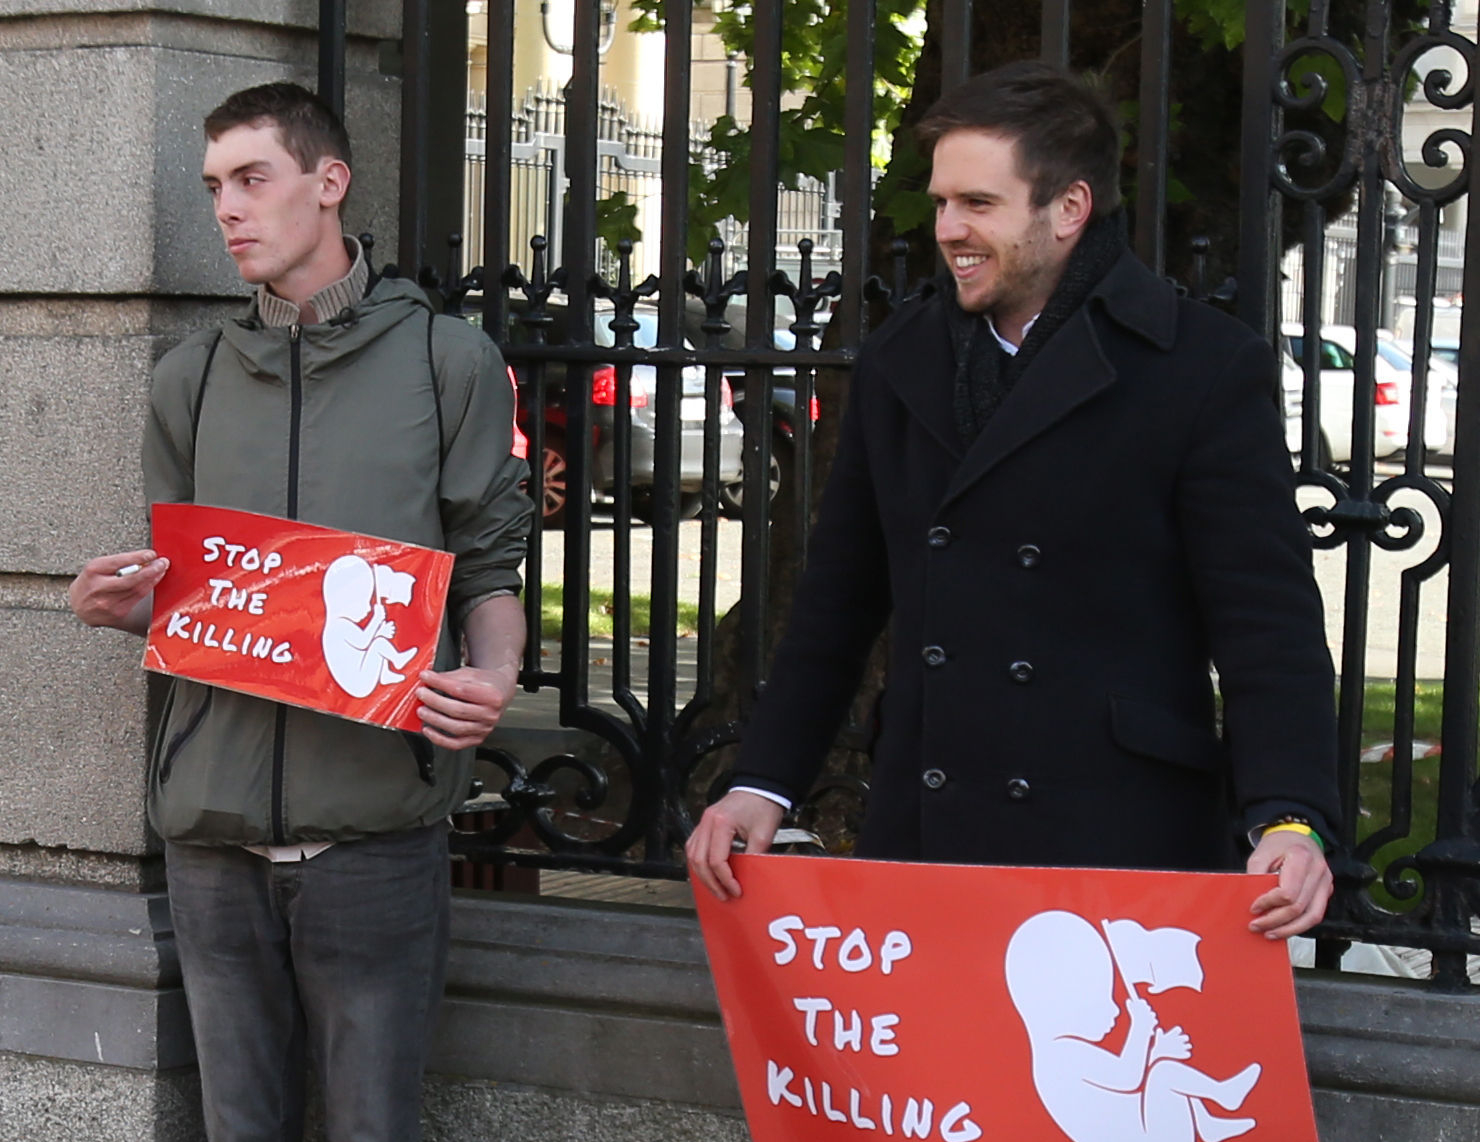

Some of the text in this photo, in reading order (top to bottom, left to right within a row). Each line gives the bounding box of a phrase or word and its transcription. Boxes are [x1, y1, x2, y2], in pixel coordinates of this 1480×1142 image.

[203, 536, 283, 575] STOP
[209, 578, 268, 615] THE
[166, 612, 293, 663] KILLING
[768, 914, 913, 975] STOP
[793, 997, 900, 1056] THE
